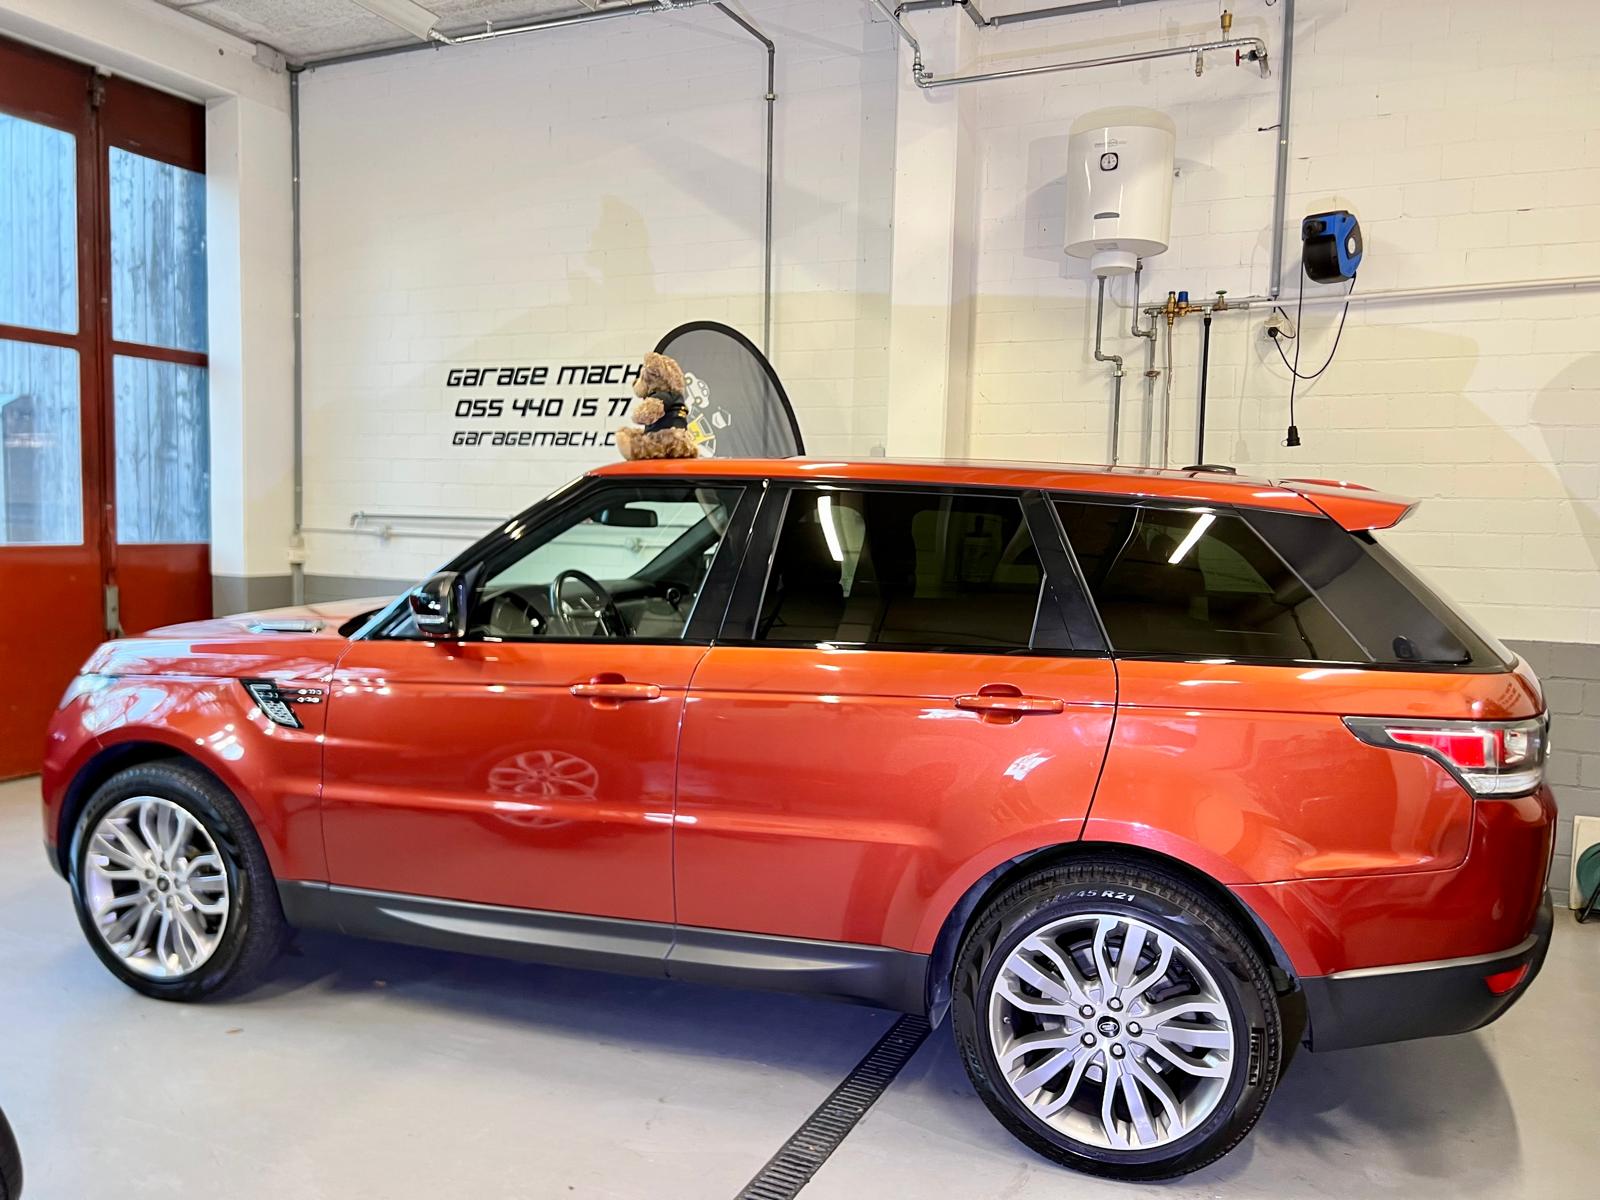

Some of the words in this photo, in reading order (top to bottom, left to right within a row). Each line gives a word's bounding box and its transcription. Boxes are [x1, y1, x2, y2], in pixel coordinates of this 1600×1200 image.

[454, 398, 504, 417] 055
[512, 397, 564, 417] 440
[572, 397, 599, 417] 15
[607, 397, 633, 417] 77
[1101, 889, 1136, 902] R21
